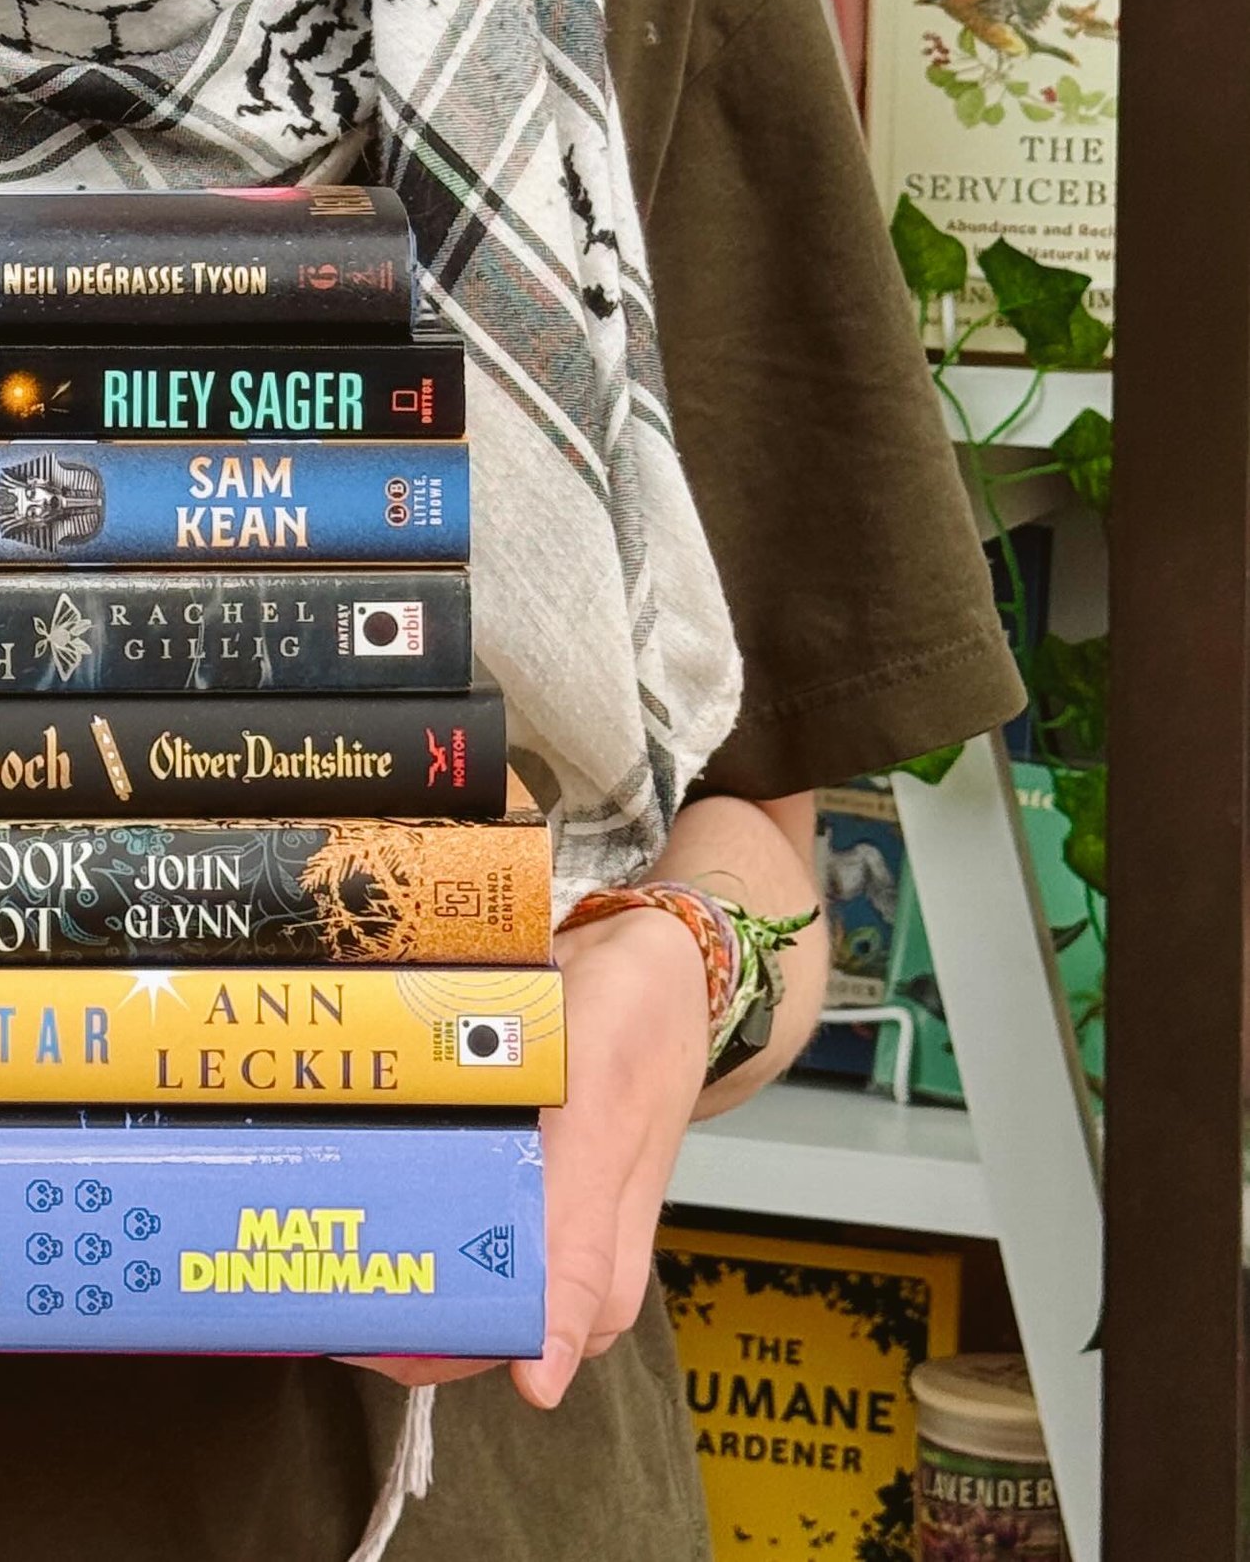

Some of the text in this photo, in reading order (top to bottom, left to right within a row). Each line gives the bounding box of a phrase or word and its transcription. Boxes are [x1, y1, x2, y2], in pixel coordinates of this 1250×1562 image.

[1020, 136, 1104, 165] THE
[905, 173, 1113, 207] SERVICEB
[1043, 223, 1073, 236] and
[1026, 246, 1090, 261] Natural
[191, 261, 267, 295] TYSON
[104, 370, 215, 429] RILEY
[229, 371, 363, 430] SAGER
[421, 377, 434, 424] DUTTON
[188, 456, 294, 498] SAM
[414, 474, 427, 526] LITTLE,
[429, 478, 443, 526] BROWN
[175, 506, 310, 549] KEAN
[110, 602, 315, 627] RACHEL
[337, 604, 350, 656] FANTASY
[402, 605, 420, 651] orbit
[123, 636, 301, 660] GILLIG
[149, 730, 241, 781] Oliver
[242, 729, 393, 783] Darkshire
[452, 728, 465, 787] NORTON
[134, 854, 240, 891] JOHN
[487, 871, 499, 925] GRAND
[502, 865, 513, 933] CENTRAL
[123, 904, 252, 940] GLYNN
[204, 983, 345, 1026] ANN
[433, 1020, 442, 1062] SCIENCE
[445, 1020, 454, 1061] FICTION
[503, 1020, 519, 1062] orbit
[155, 1048, 399, 1092] LECKIE
[237, 1207, 366, 1251] MATT
[494, 1224, 510, 1278] ACE
[179, 1251, 436, 1295] DINNIMAN
[735, 1332, 803, 1366] THE
[686, 1369, 897, 1435] UMANE
[696, 1430, 863, 1472] ARDENER
[923, 1470, 1057, 1509] LAVENDER
